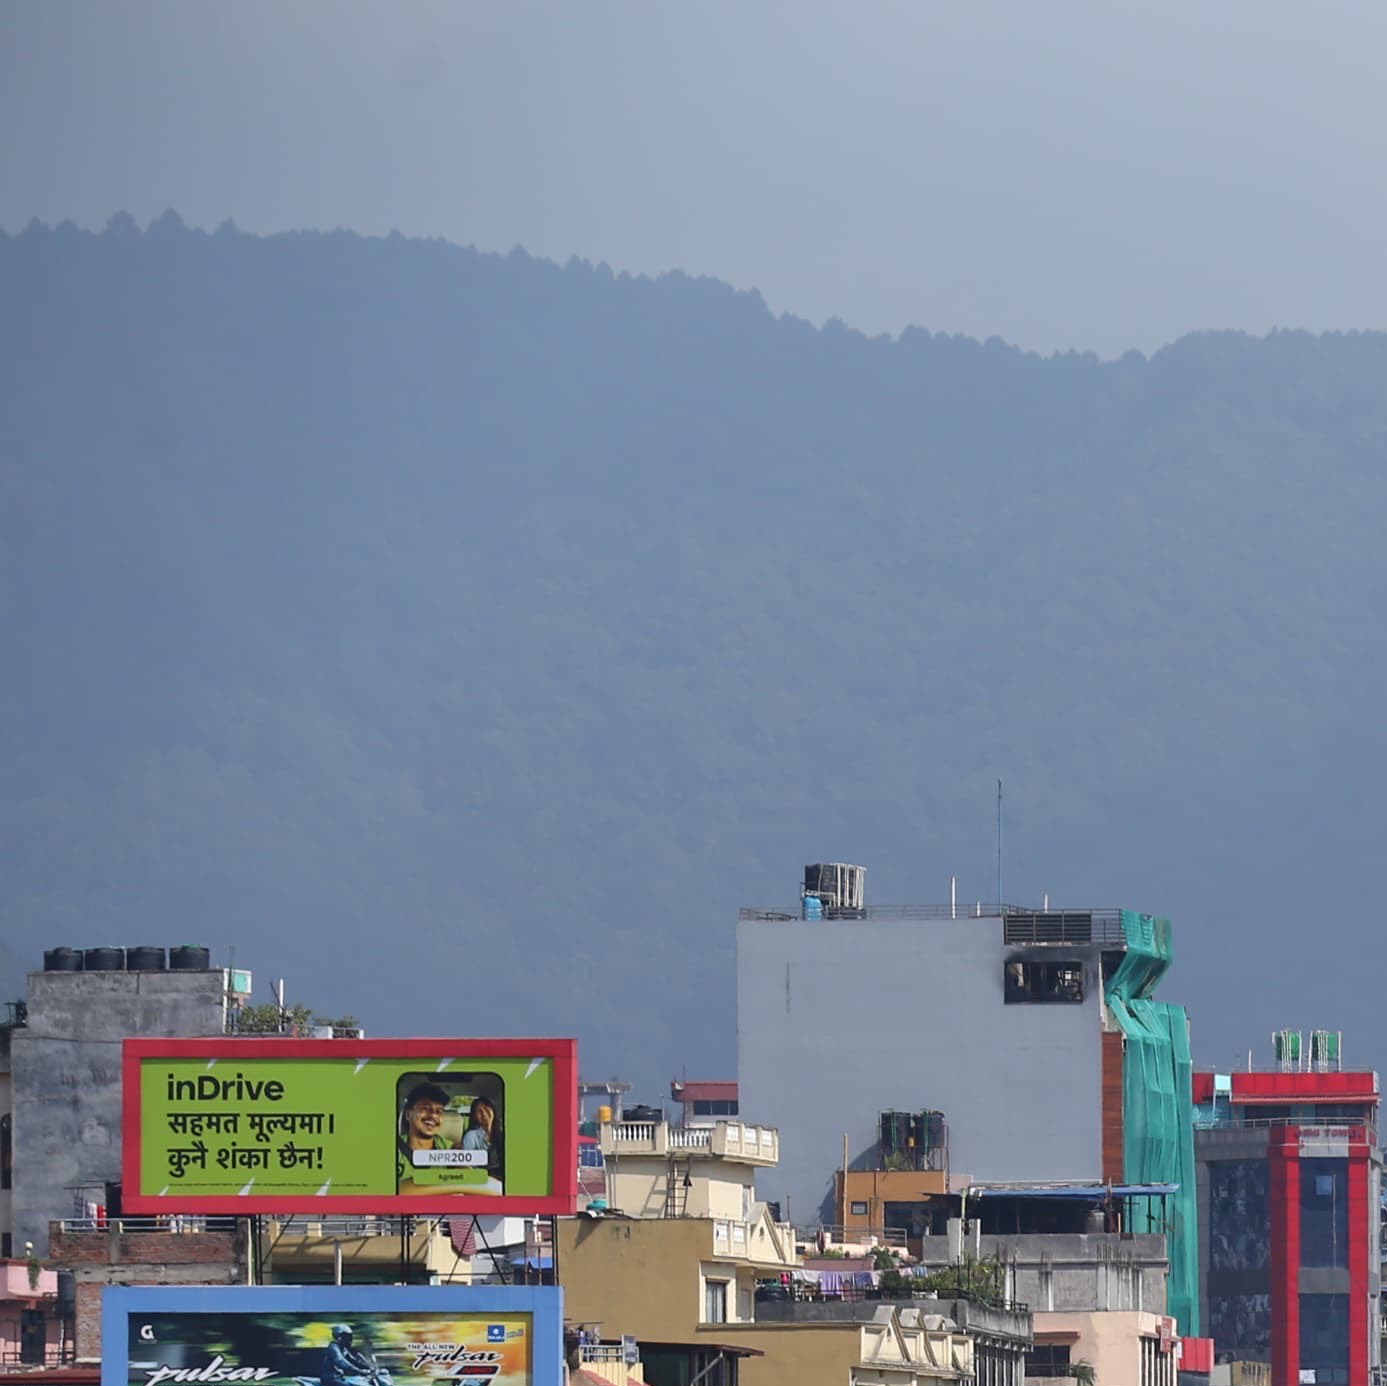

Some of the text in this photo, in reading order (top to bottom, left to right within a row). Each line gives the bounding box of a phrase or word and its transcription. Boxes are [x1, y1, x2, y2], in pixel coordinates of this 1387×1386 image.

[167, 1073, 285, 1101] inDrive
[167, 1113, 334, 1142] सहमत मूल्यमा।
[167, 1140, 323, 1178] कुनै शंका छैन!
[428, 1152, 473, 1163] NPR200
[413, 1345, 501, 1369] pulsar
